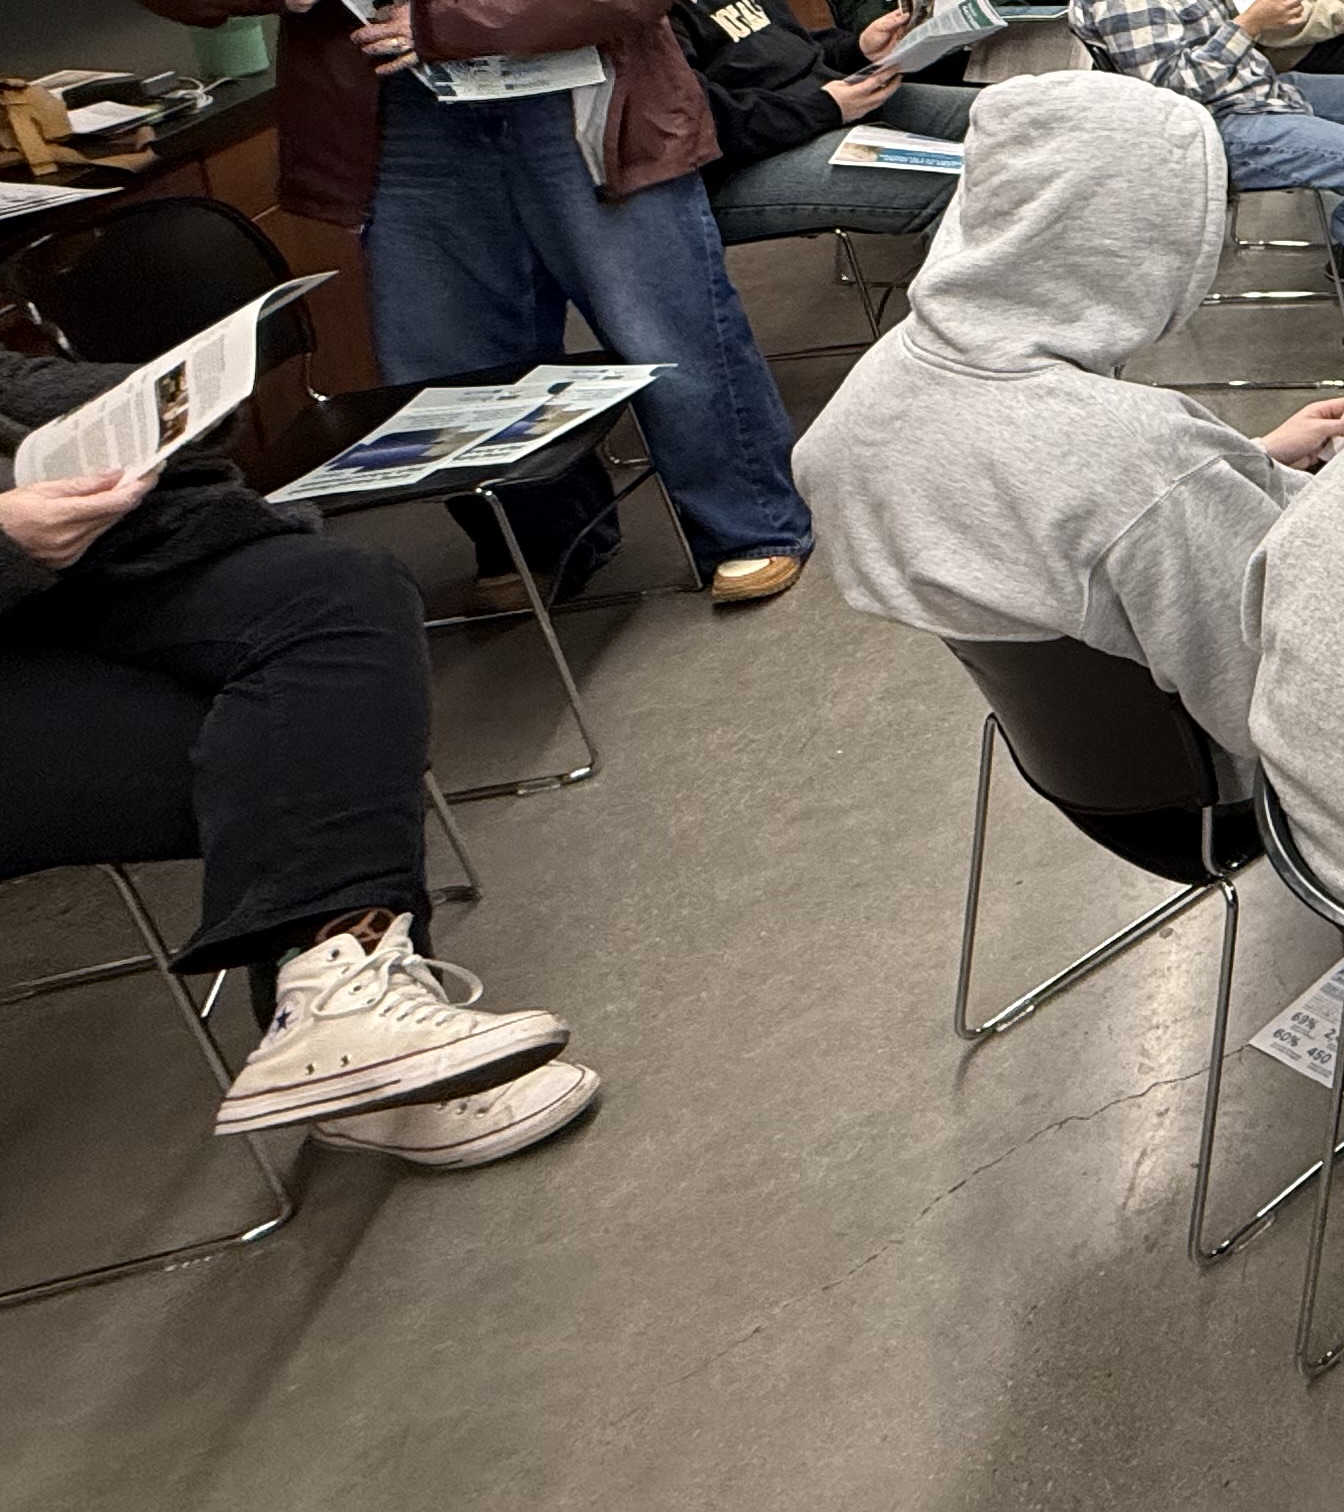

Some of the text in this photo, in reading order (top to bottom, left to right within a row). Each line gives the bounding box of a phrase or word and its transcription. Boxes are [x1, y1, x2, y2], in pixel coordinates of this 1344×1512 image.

[1291, 1011, 1318, 1030] 69%
[1273, 1028, 1300, 1047] 60%
[1306, 1047, 1333, 1065] 450
